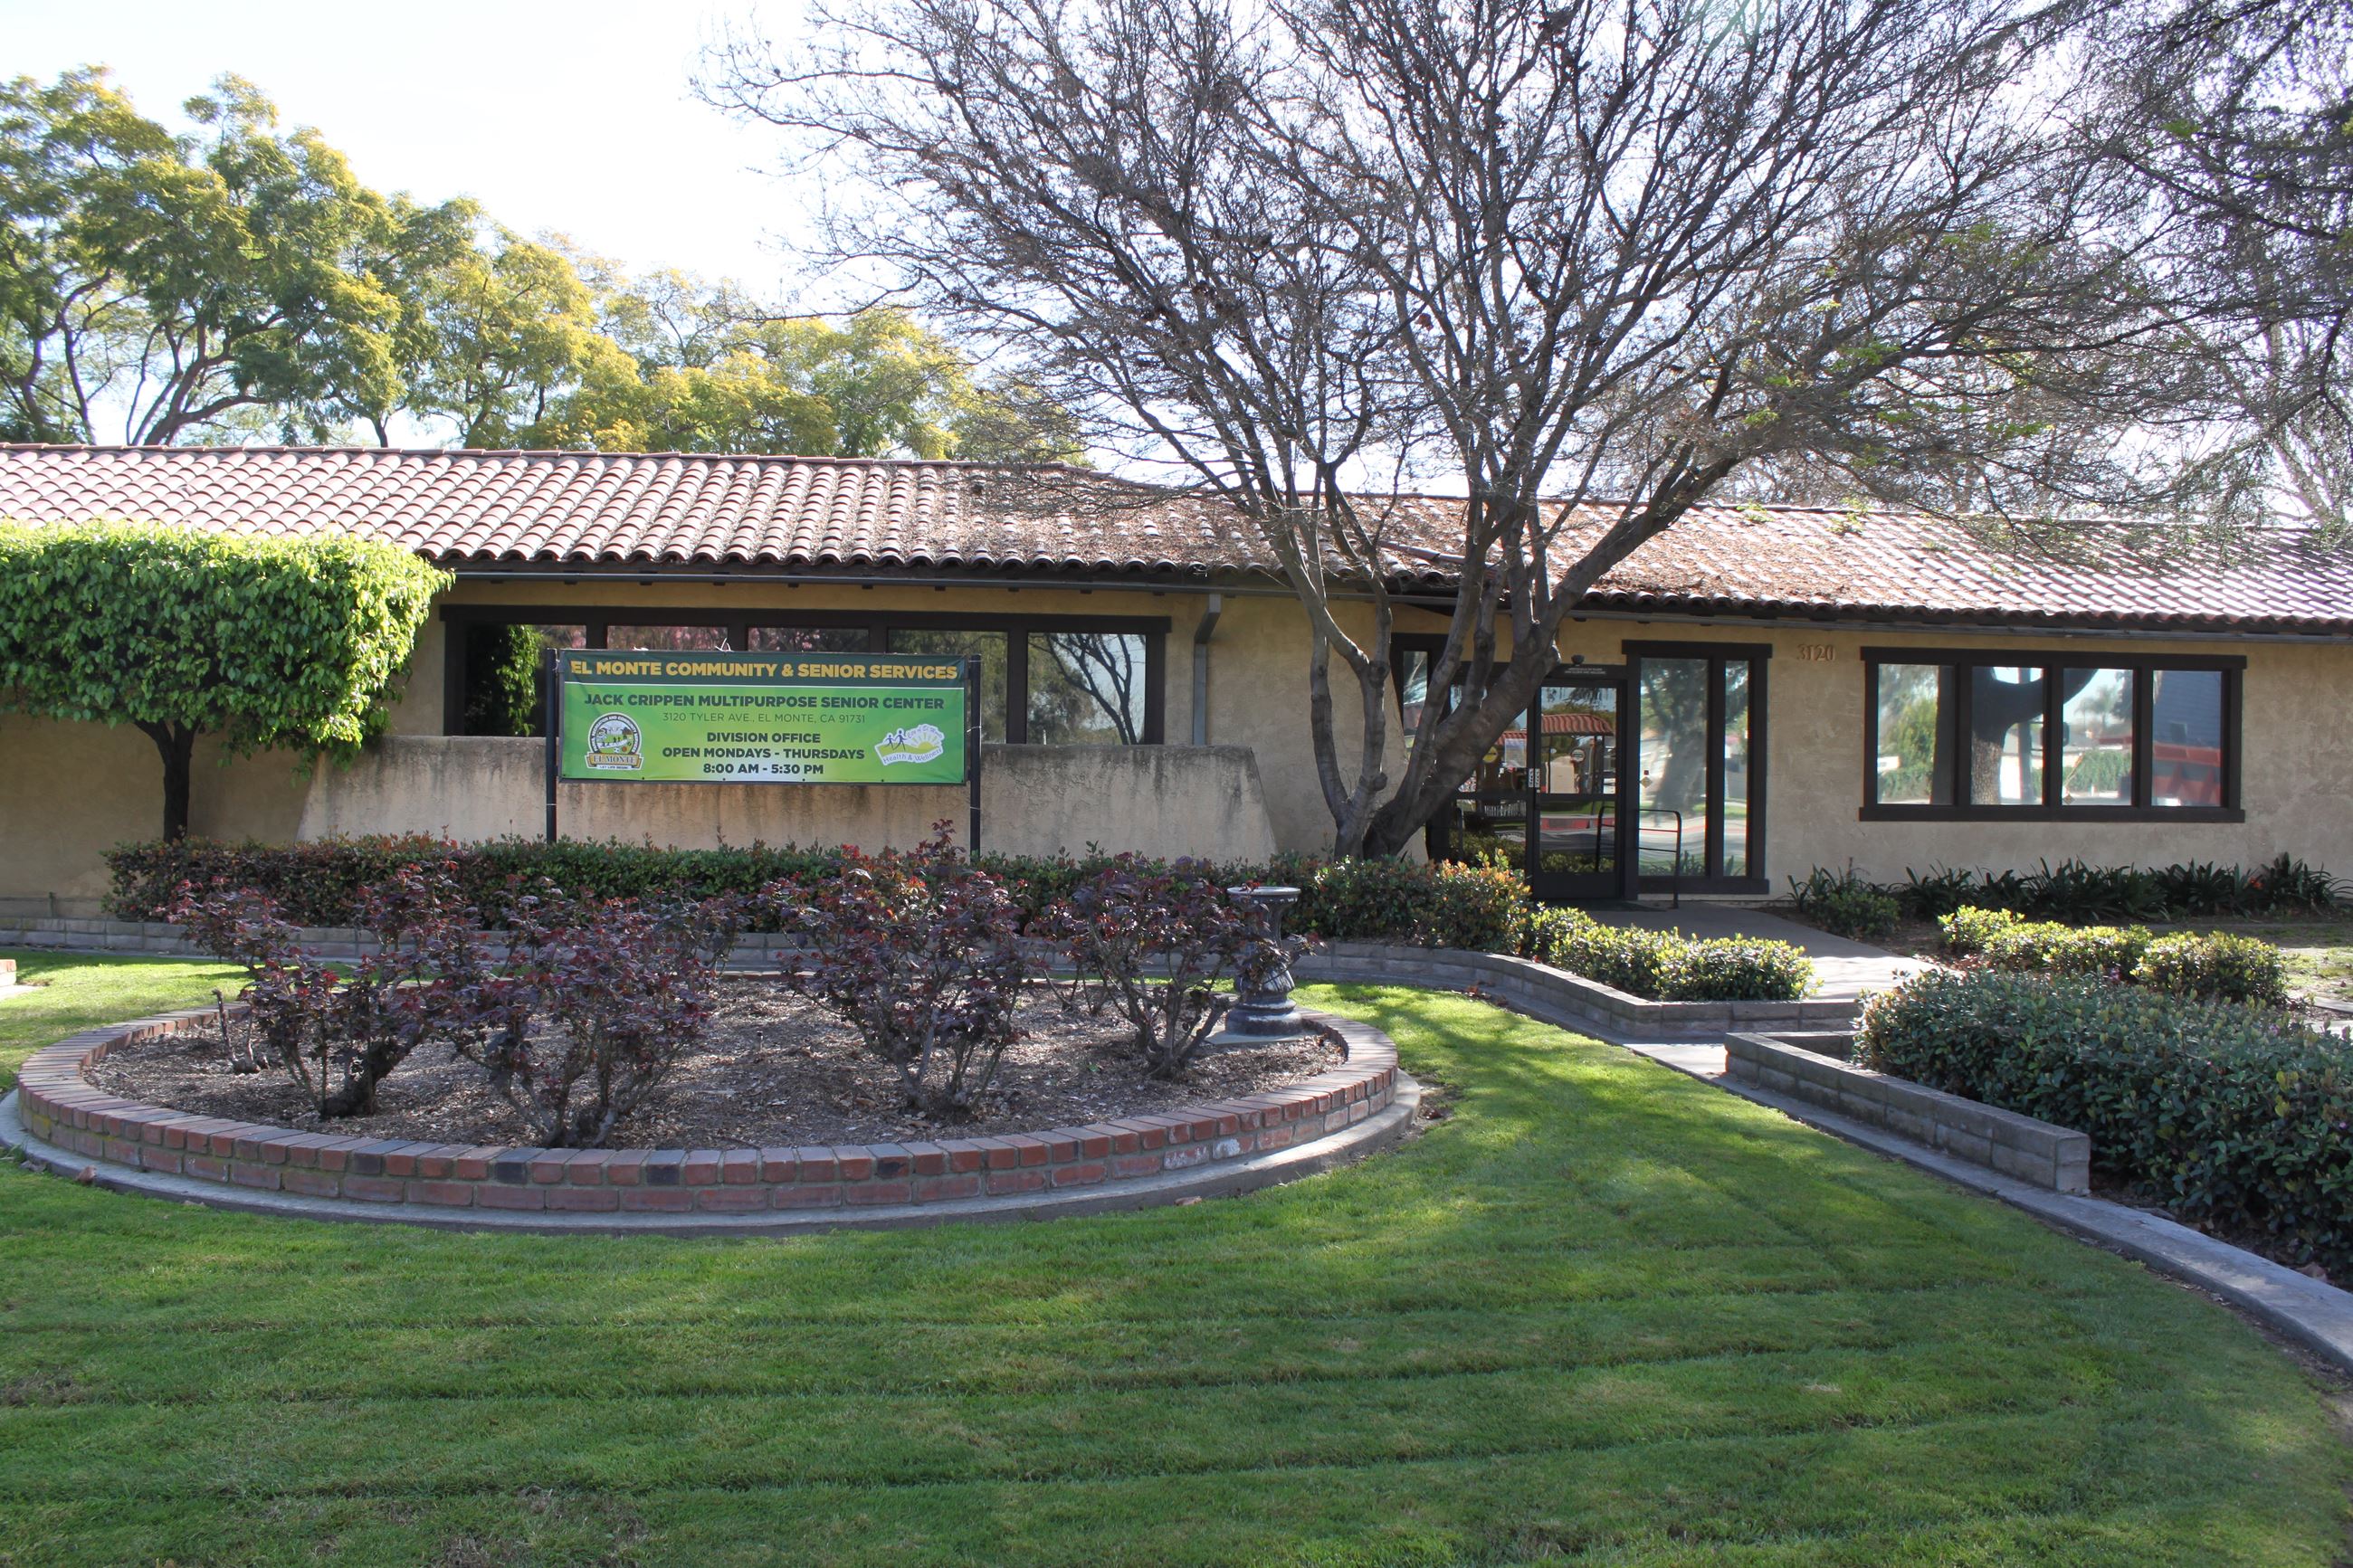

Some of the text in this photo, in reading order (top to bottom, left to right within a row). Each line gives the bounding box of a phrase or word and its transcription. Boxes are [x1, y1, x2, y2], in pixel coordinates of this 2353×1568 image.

[1796, 643, 1835, 661] 3120
[570, 660, 957, 679] EL MONTE COMMUNITY & SENIOR SERVICES
[585, 694, 944, 709] JACK CRIPPEN MULTIPURPOSE SENIOR CENTER
[662, 712, 687, 721] 3120
[691, 713, 724, 722] TYLER
[757, 714, 770, 723] EL
[775, 714, 817, 724] MONTE,
[820, 715, 838, 724] CA
[838, 715, 866, 724] 91731
[707, 732, 821, 743] DIVISION OFFICE
[662, 747, 700, 757] OPEN
[704, 747, 771, 758] MONDAYS
[783, 748, 865, 759] THURSDAYS
[882, 754, 907, 764] Health
[914, 748, 942, 762] Wellness
[593, 755, 635, 764] EL MONTE
[703, 764, 734, 774] 8:00
[738, 764, 759, 774] AM
[771, 764, 801, 774] 5:30
[804, 765, 824, 774] PM
